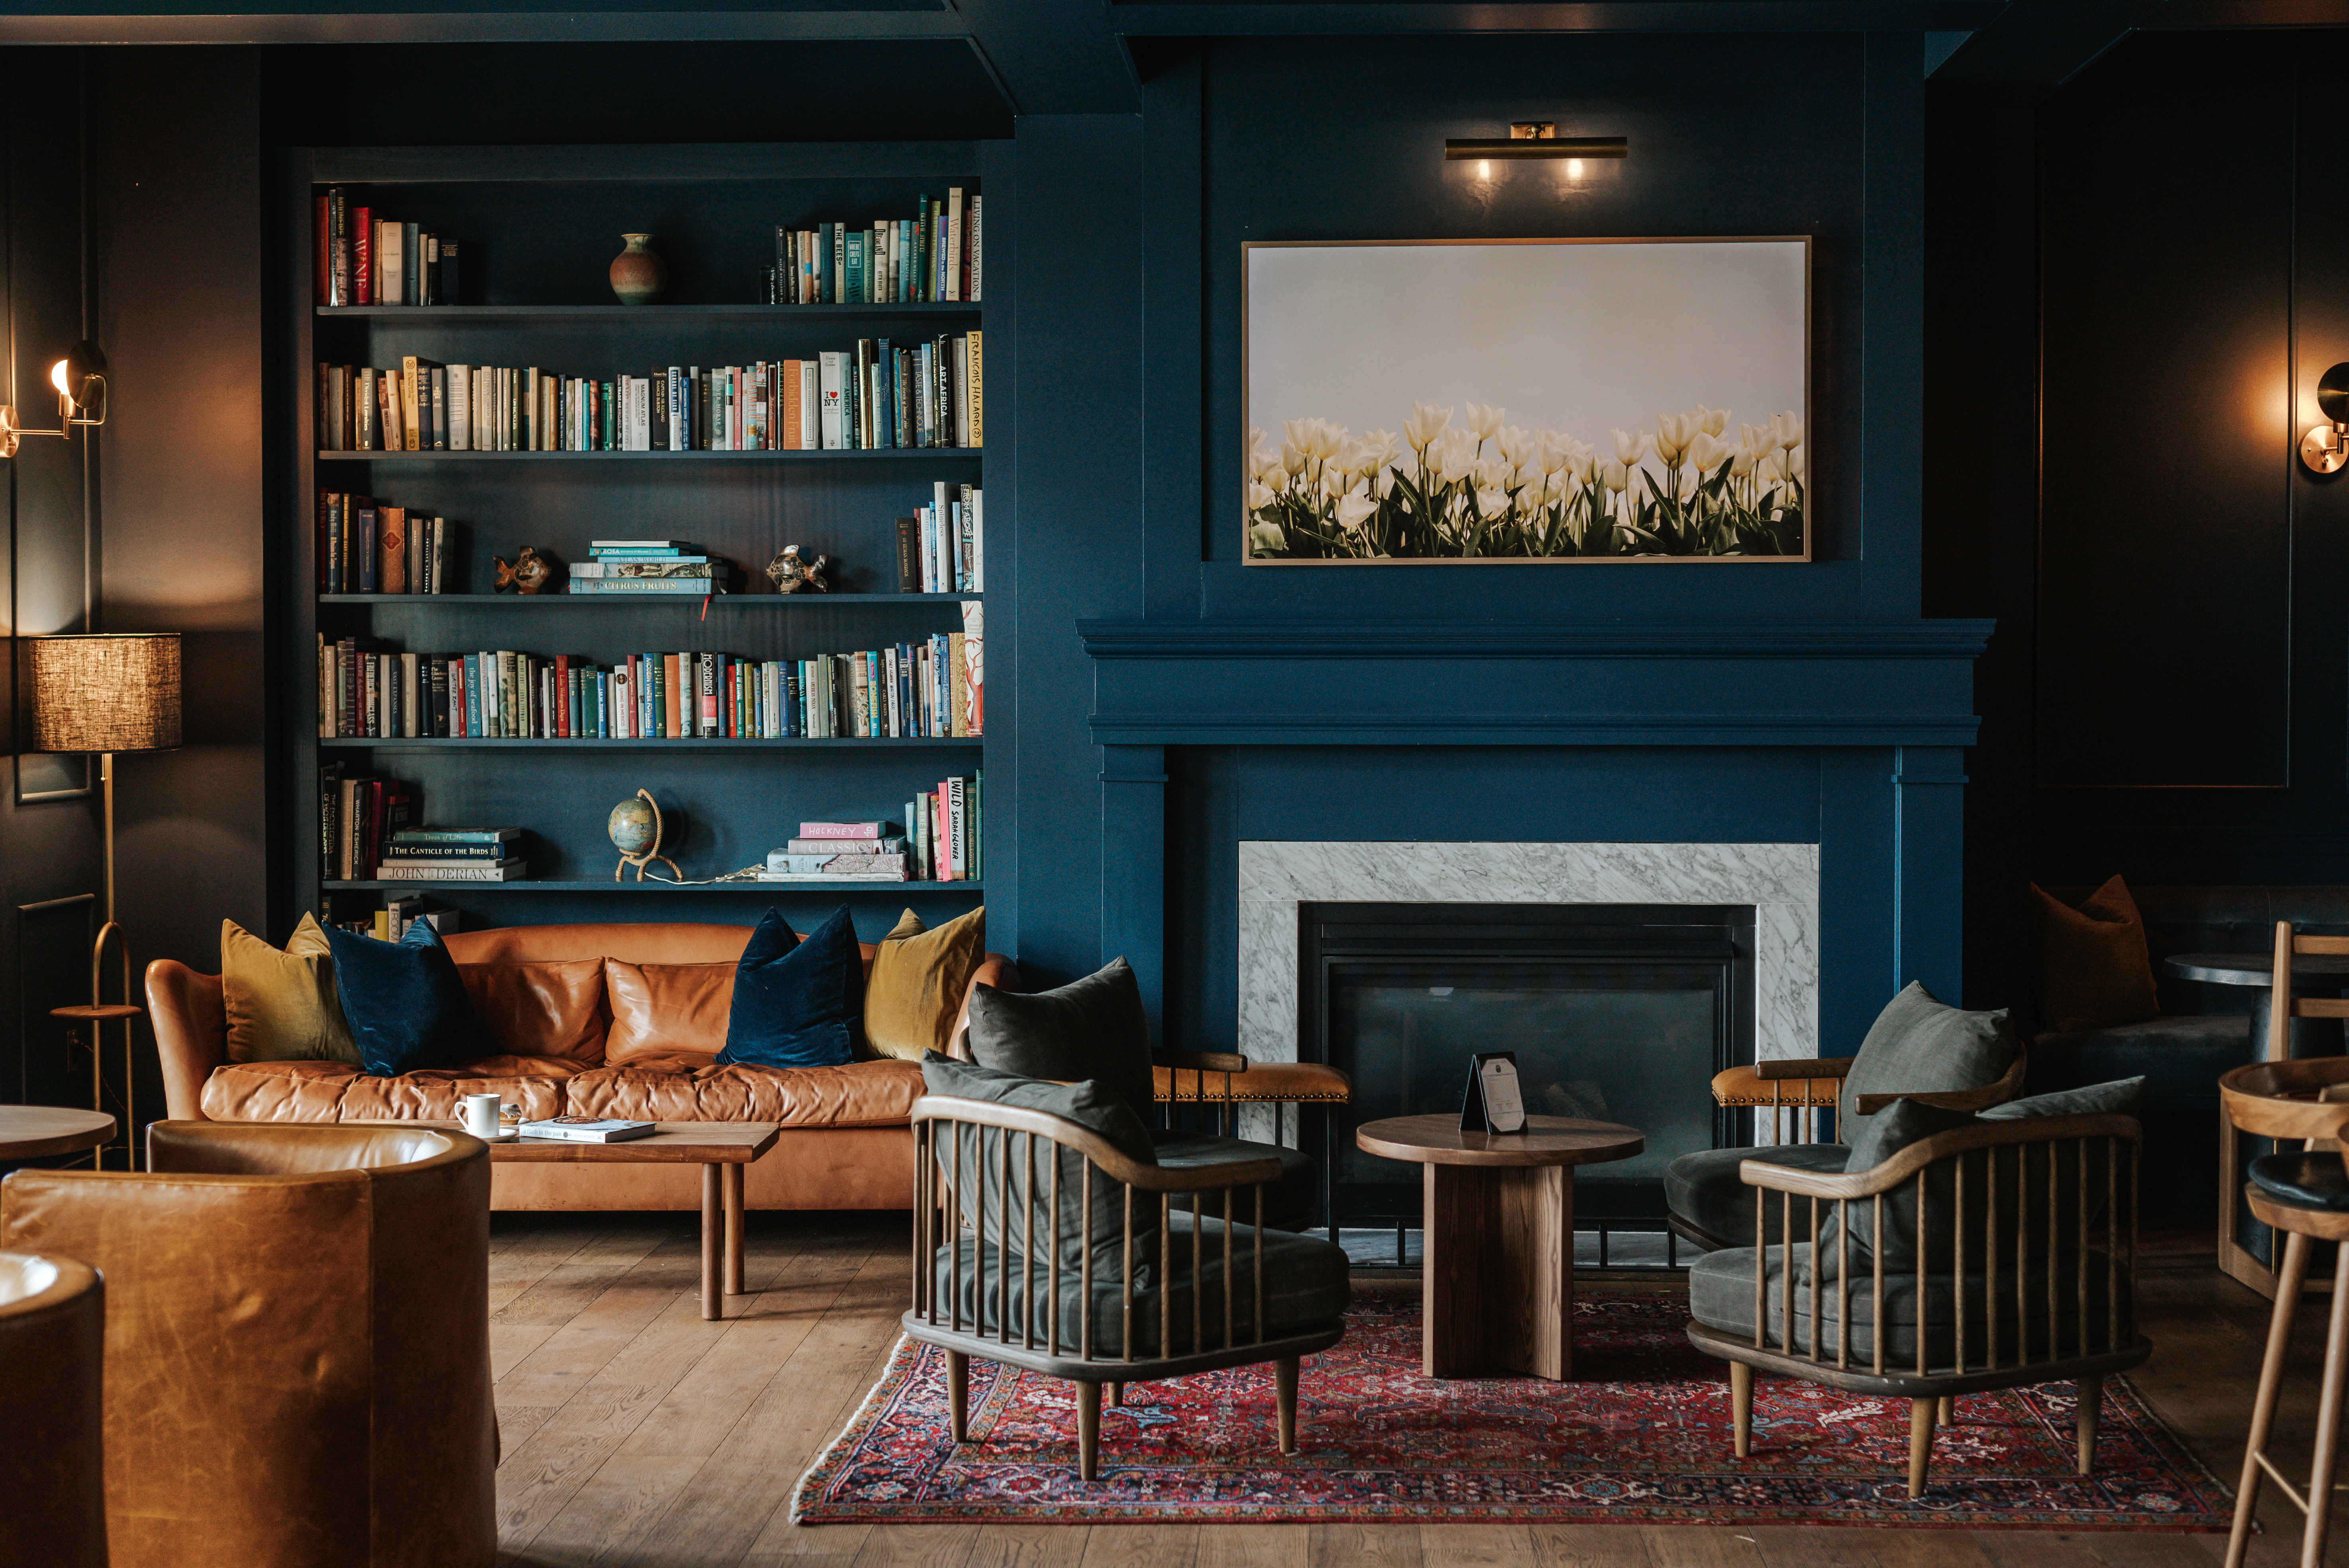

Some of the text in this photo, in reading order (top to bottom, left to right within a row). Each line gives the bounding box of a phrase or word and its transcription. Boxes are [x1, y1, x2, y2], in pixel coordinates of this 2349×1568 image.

[875, 229, 886, 255] DREAMLAND
[949, 218, 959, 271] Waterbirds
[974, 234, 980, 247] ON
[971, 334, 980, 426] FRANÇOIS HALARD
[747, 373, 757, 419] CARAMELO
[788, 368, 799, 444] Forbidden Fruit
[642, 582, 677, 590] FRUITS
[703, 654, 713, 695] MODERNISM
[951, 781, 962, 807] WILD
[809, 826, 856, 836] HOCKNEY
[809, 842, 866, 853] CLASSIC
[389, 868, 487, 880] JOHN DERIAN
